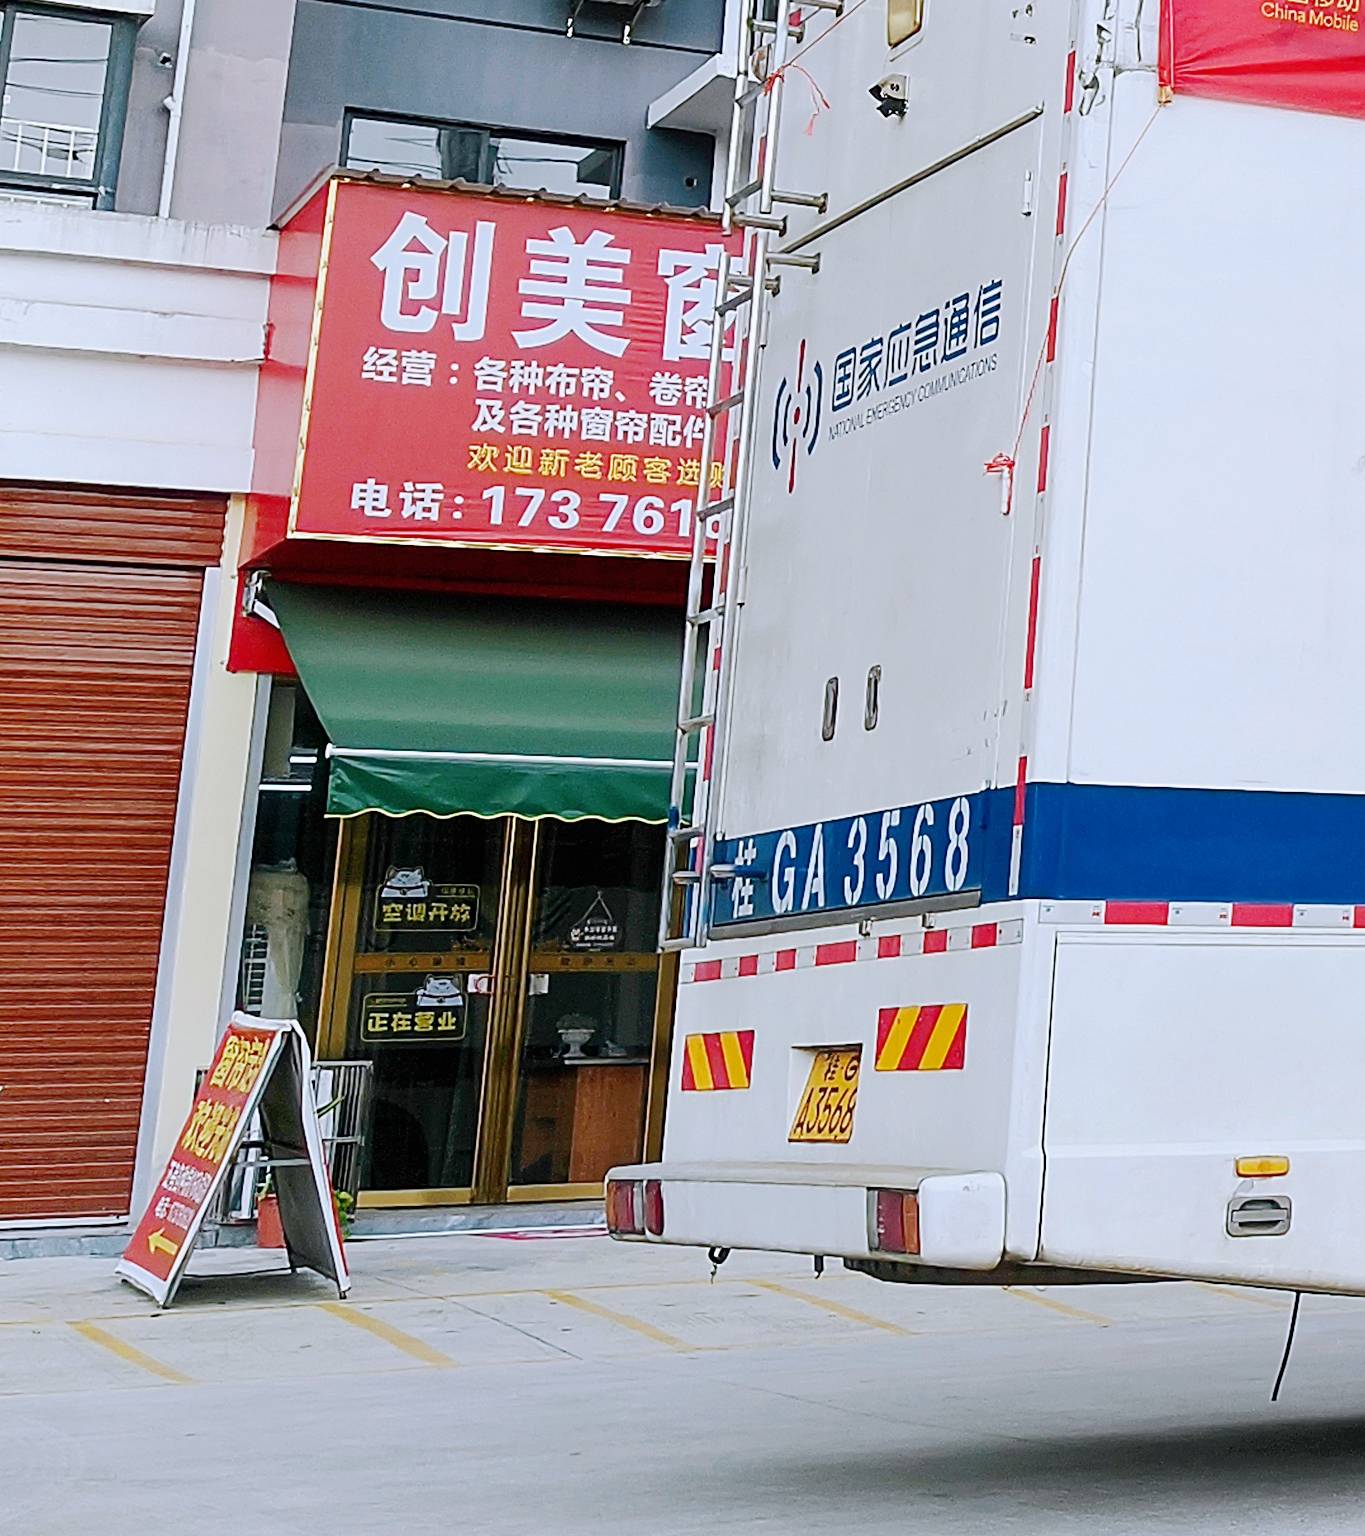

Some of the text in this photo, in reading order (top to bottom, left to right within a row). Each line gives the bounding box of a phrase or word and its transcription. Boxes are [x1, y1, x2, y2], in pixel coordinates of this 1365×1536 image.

[1260, 2, 1360, 32] China Mobile
[832, 279, 1003, 412] 国家应急通信
[382, 902, 472, 923] 空调开放
[368, 1011, 457, 1032] 正在营业
[793, 1086, 858, 1136] A3568
